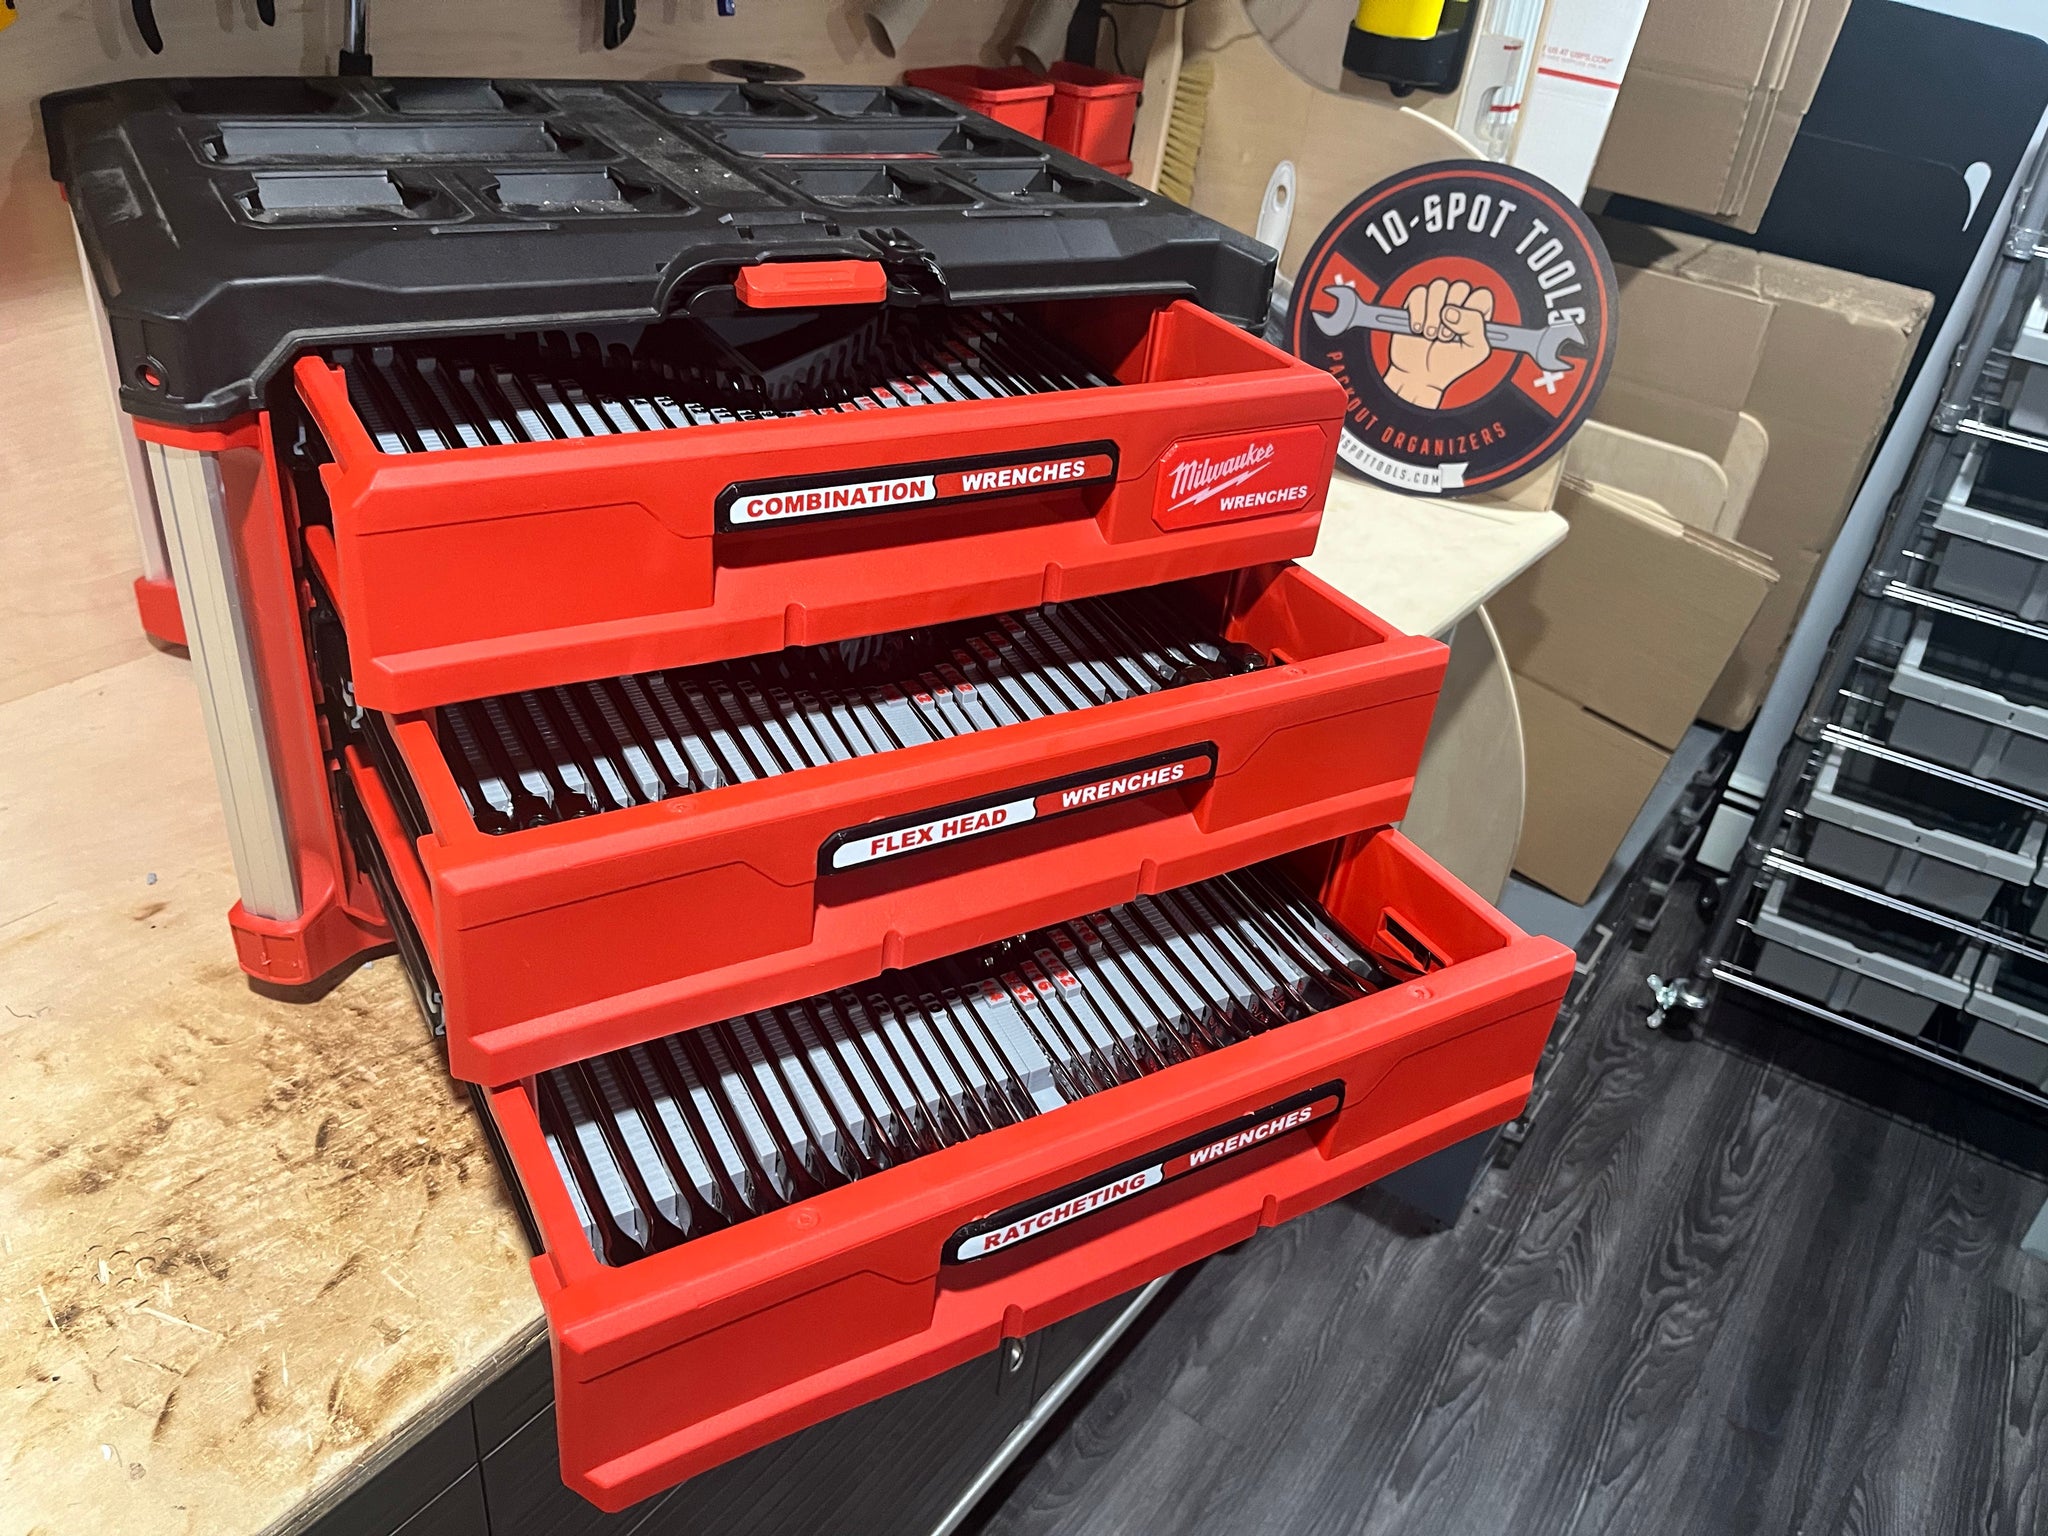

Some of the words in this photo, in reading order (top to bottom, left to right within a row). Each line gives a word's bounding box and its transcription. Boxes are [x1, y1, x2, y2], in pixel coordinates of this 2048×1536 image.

[1365, 192, 1517, 254] 10-SPOT
[1515, 218, 1586, 325] TOOLS
[1381, 421, 1506, 457] ORGANIZERS
[747, 480, 926, 518] COMBINATION
[962, 460, 1086, 492] WRENCHES
[1169, 443, 1275, 499] Milwaukee
[1220, 485, 1308, 512] WRENCHES
[870, 826, 934, 856] FLEX
[941, 808, 1008, 839] HEAD
[1061, 764, 1185, 808] WRENCHES
[983, 1173, 1146, 1251] RATCHETING
[1189, 1106, 1313, 1167] WRENCHES
